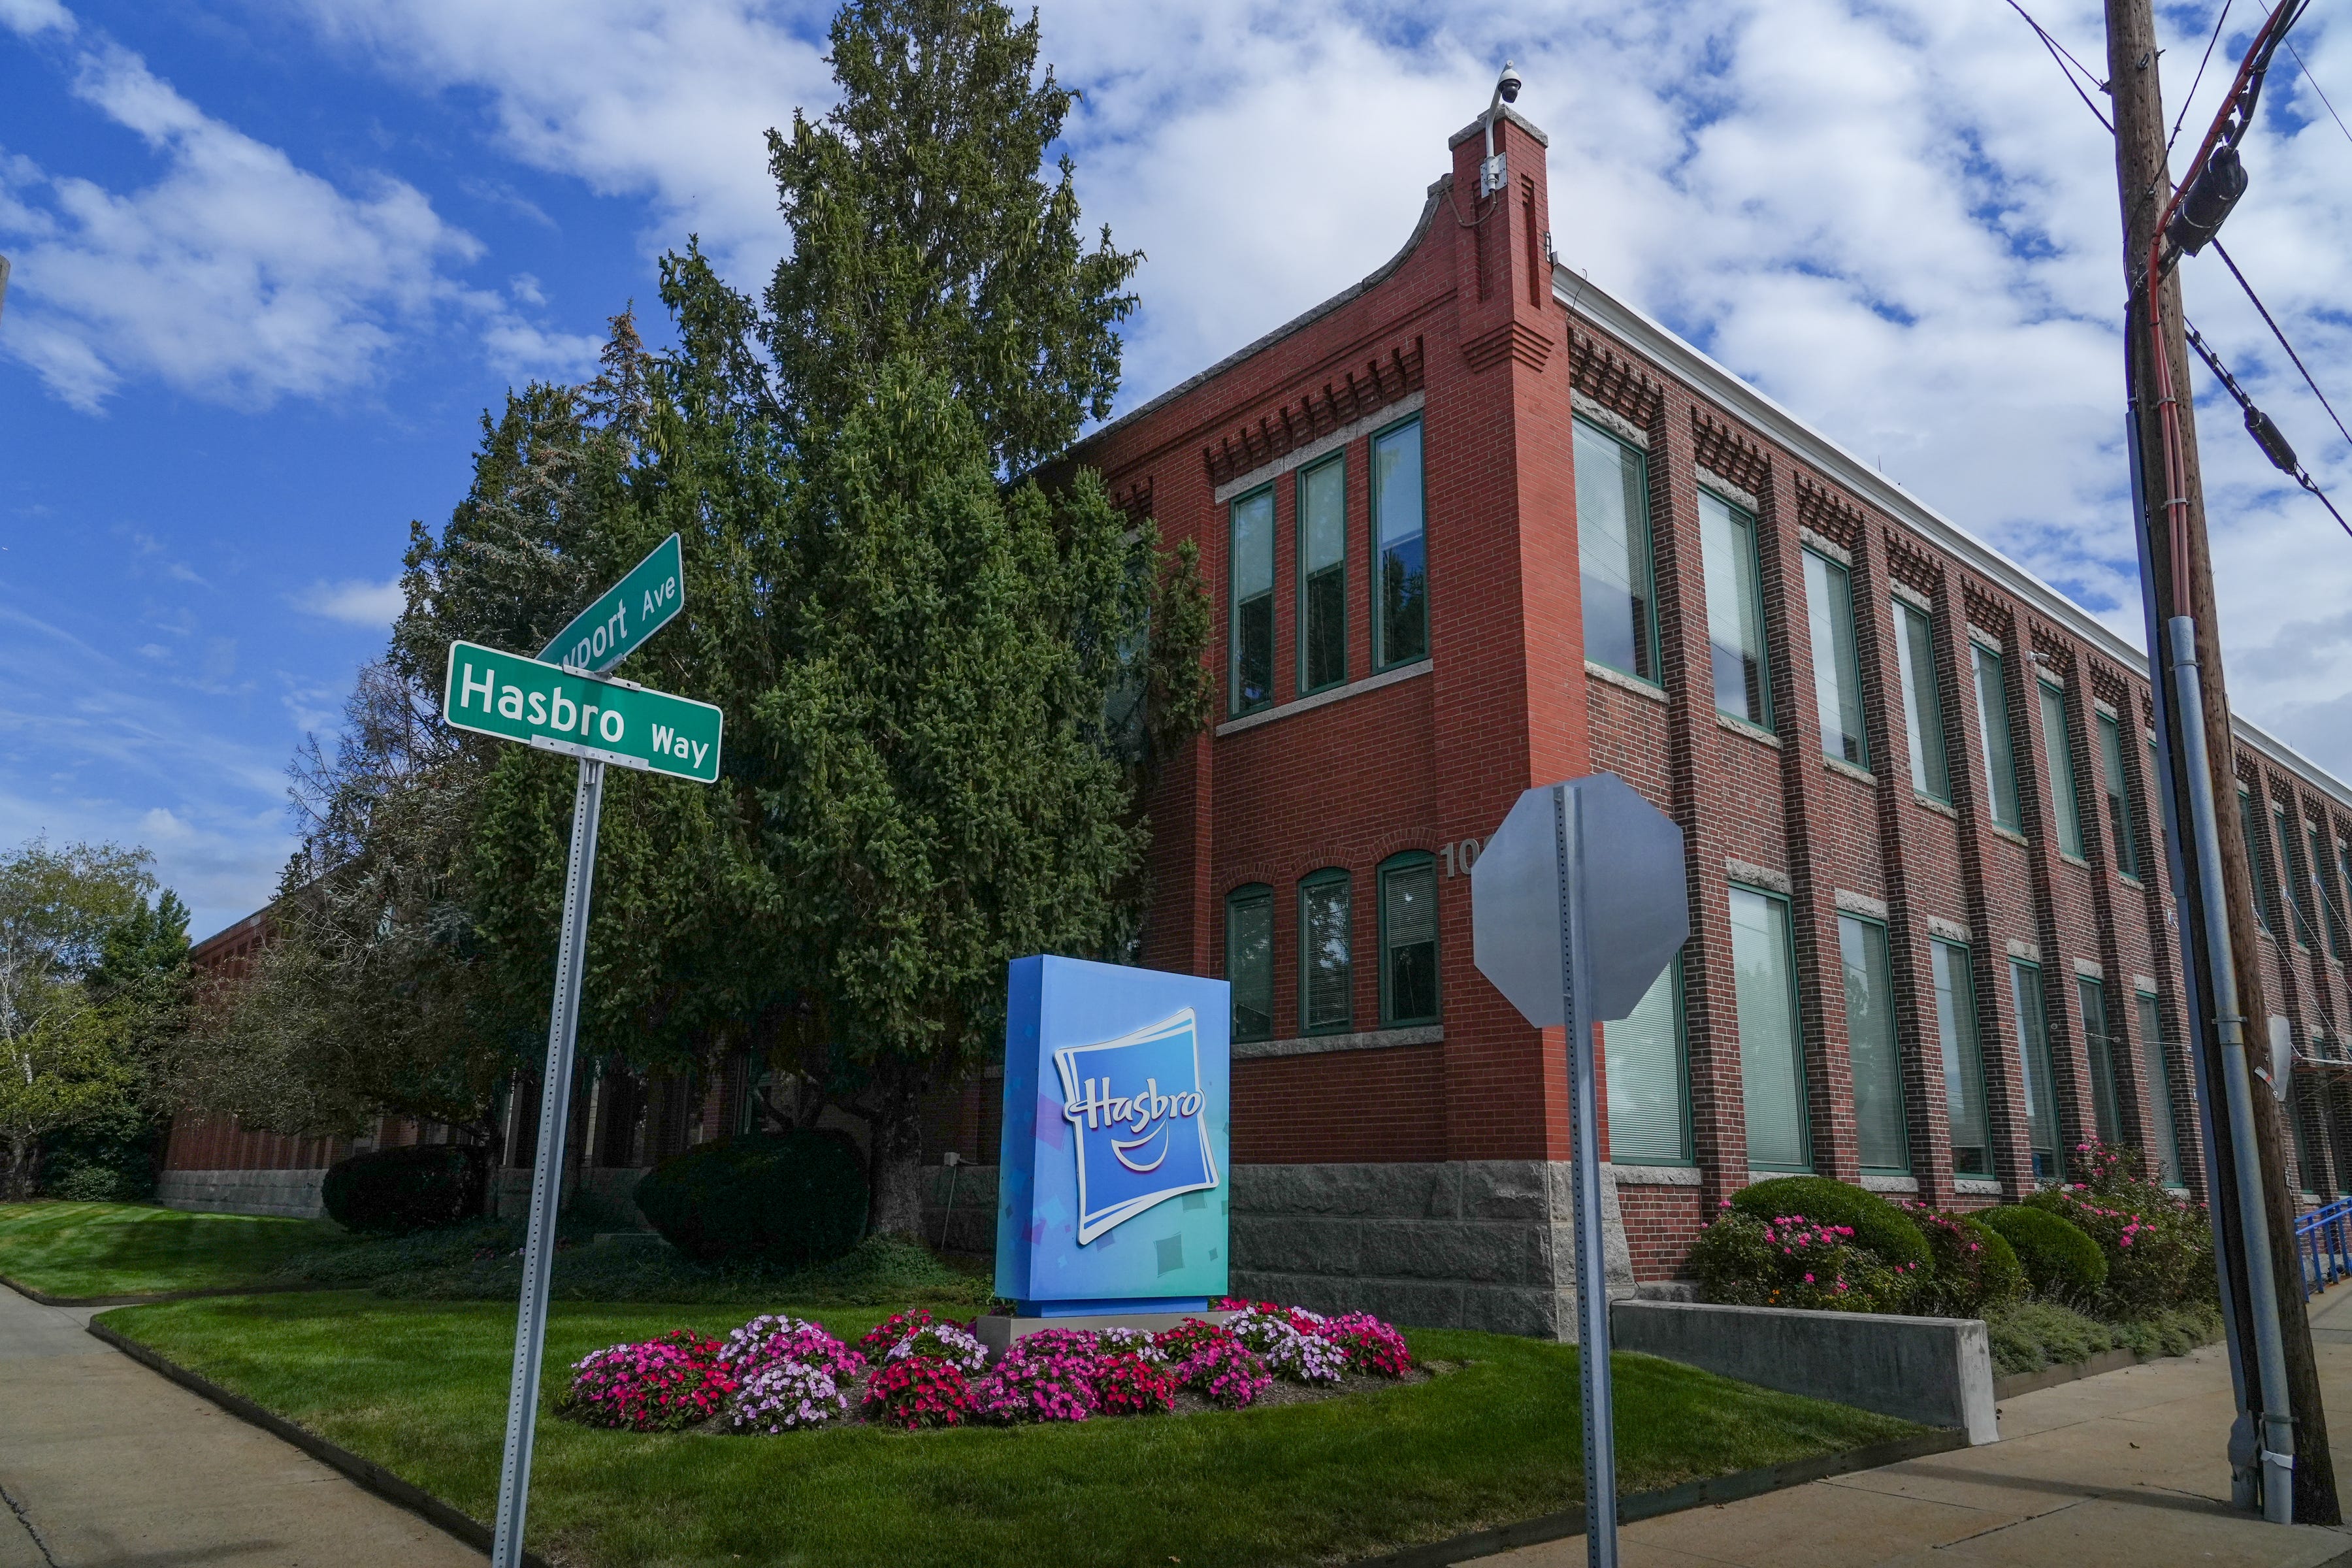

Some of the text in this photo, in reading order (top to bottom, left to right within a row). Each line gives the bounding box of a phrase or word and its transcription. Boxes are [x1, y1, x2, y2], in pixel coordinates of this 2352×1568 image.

[642, 576, 675, 621] Ave
[461, 663, 709, 768] Hasbro Way
[1440, 834, 1495, 877] 10
[1070, 1077, 1201, 1132] Hasbro
